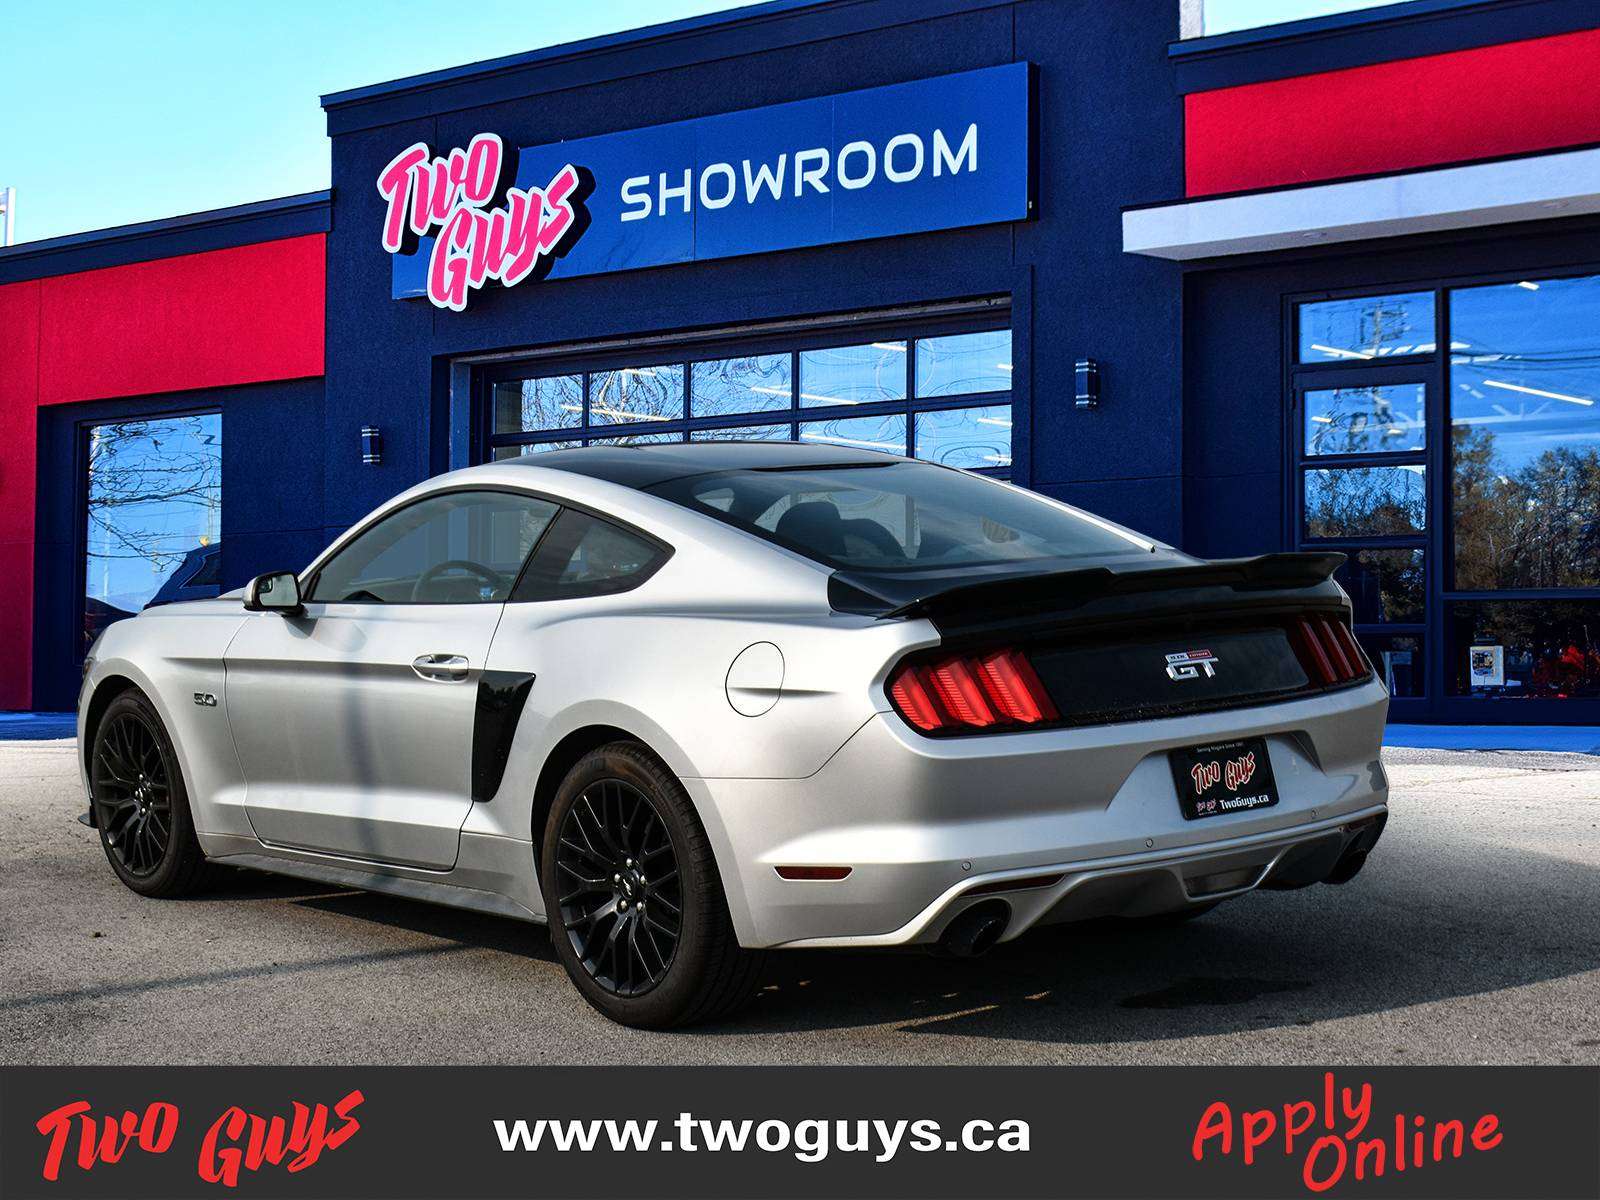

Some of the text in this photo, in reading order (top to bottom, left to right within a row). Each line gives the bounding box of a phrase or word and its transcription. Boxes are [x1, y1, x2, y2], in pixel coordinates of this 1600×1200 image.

[380, 136, 502, 251] Two
[620, 123, 979, 223] SHOWROOM
[430, 167, 578, 308] Guys
[1166, 656, 1219, 682] GT
[1191, 751, 1256, 795] Two Guys
[1219, 794, 1270, 811] TwoGuys.ca
